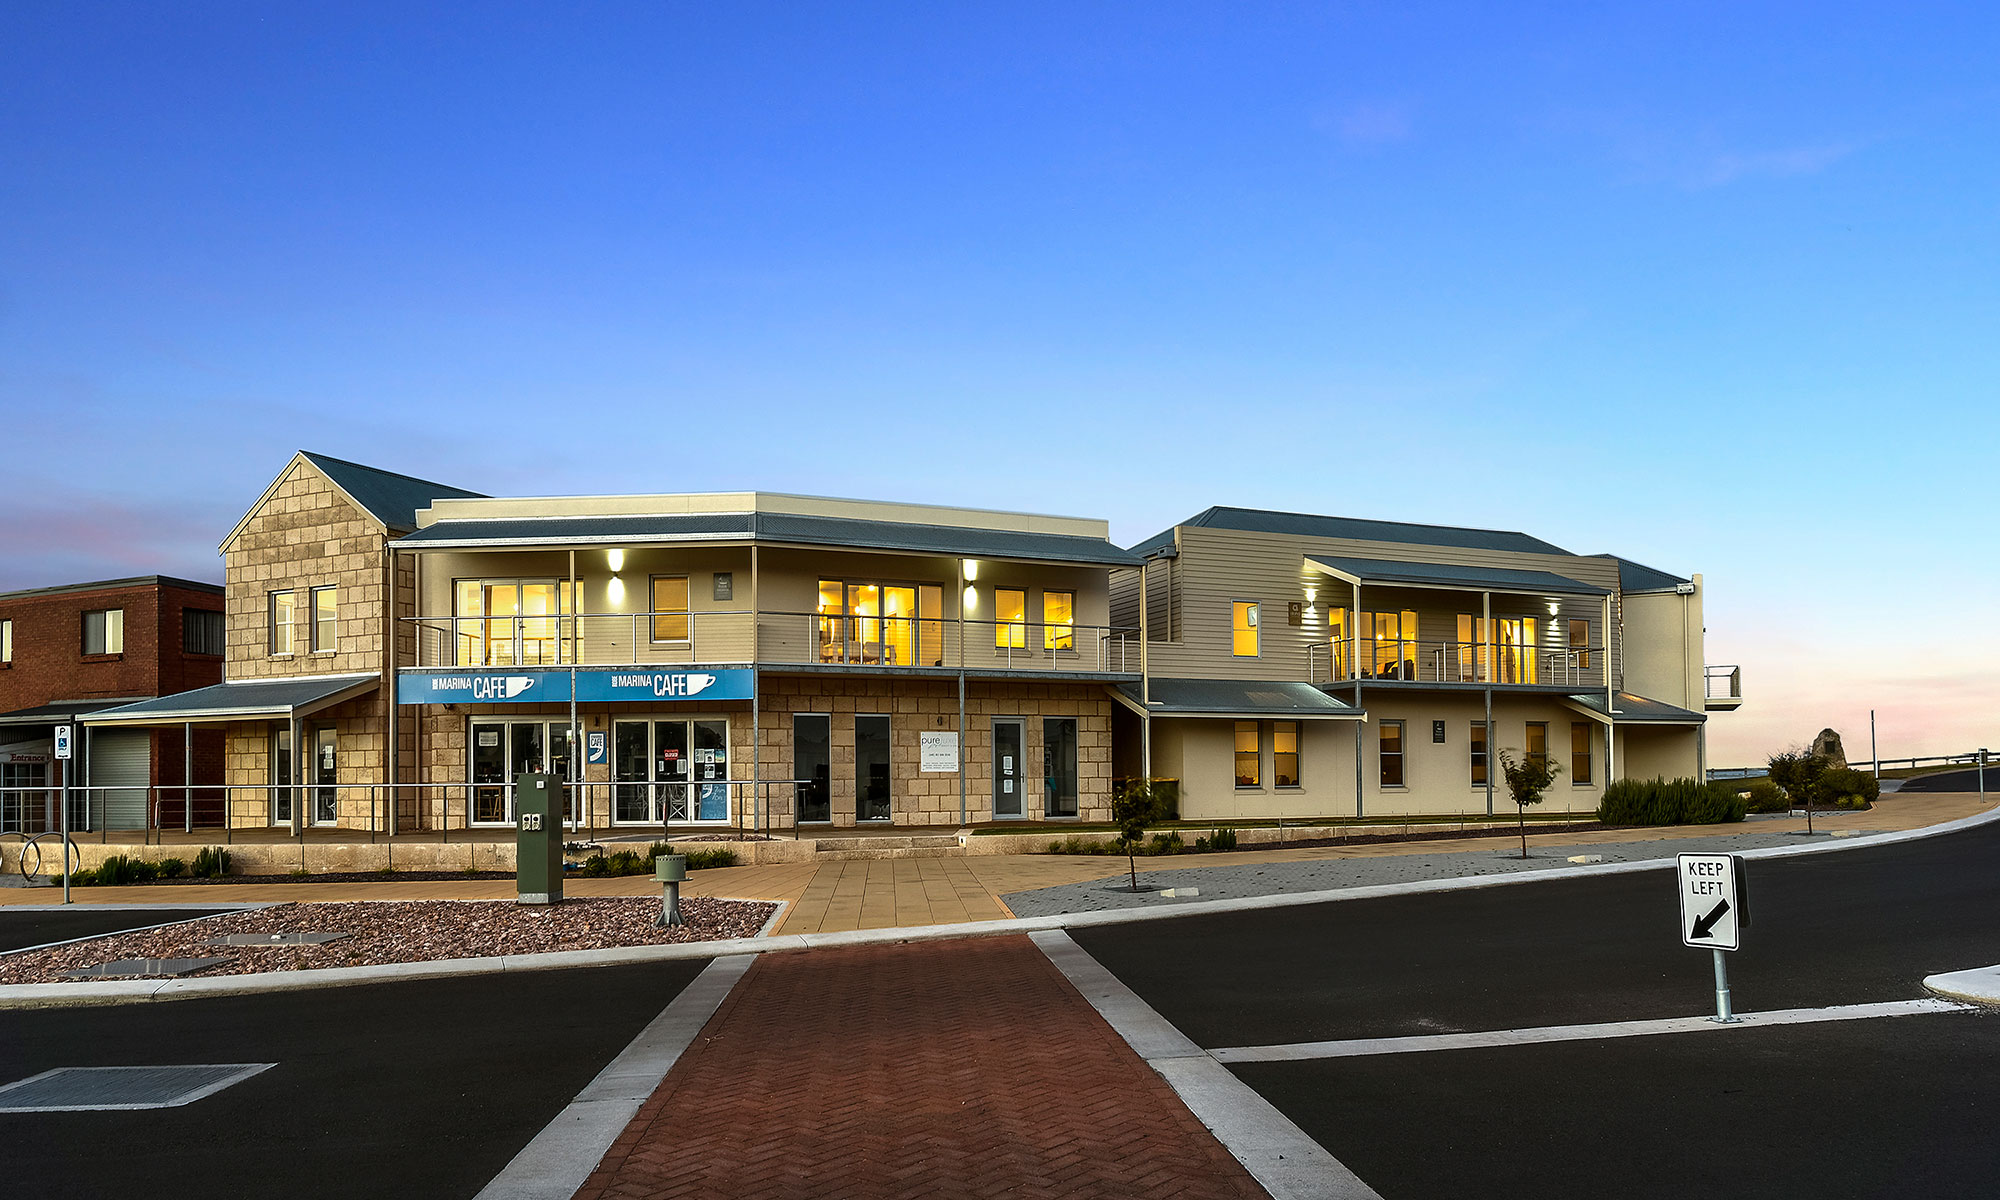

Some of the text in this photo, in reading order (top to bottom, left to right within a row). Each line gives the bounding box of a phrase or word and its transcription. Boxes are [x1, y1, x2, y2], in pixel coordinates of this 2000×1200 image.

[438, 677, 472, 690] MARINA
[473, 676, 505, 699] CAFE
[618, 674, 652, 687] MARINA
[653, 674, 686, 696] CAFE
[59, 727, 66, 736] P
[10, 753, 45, 762] Entrance
[1688, 862, 1724, 877] KEEP
[1691, 880, 1723, 896] LEFT
